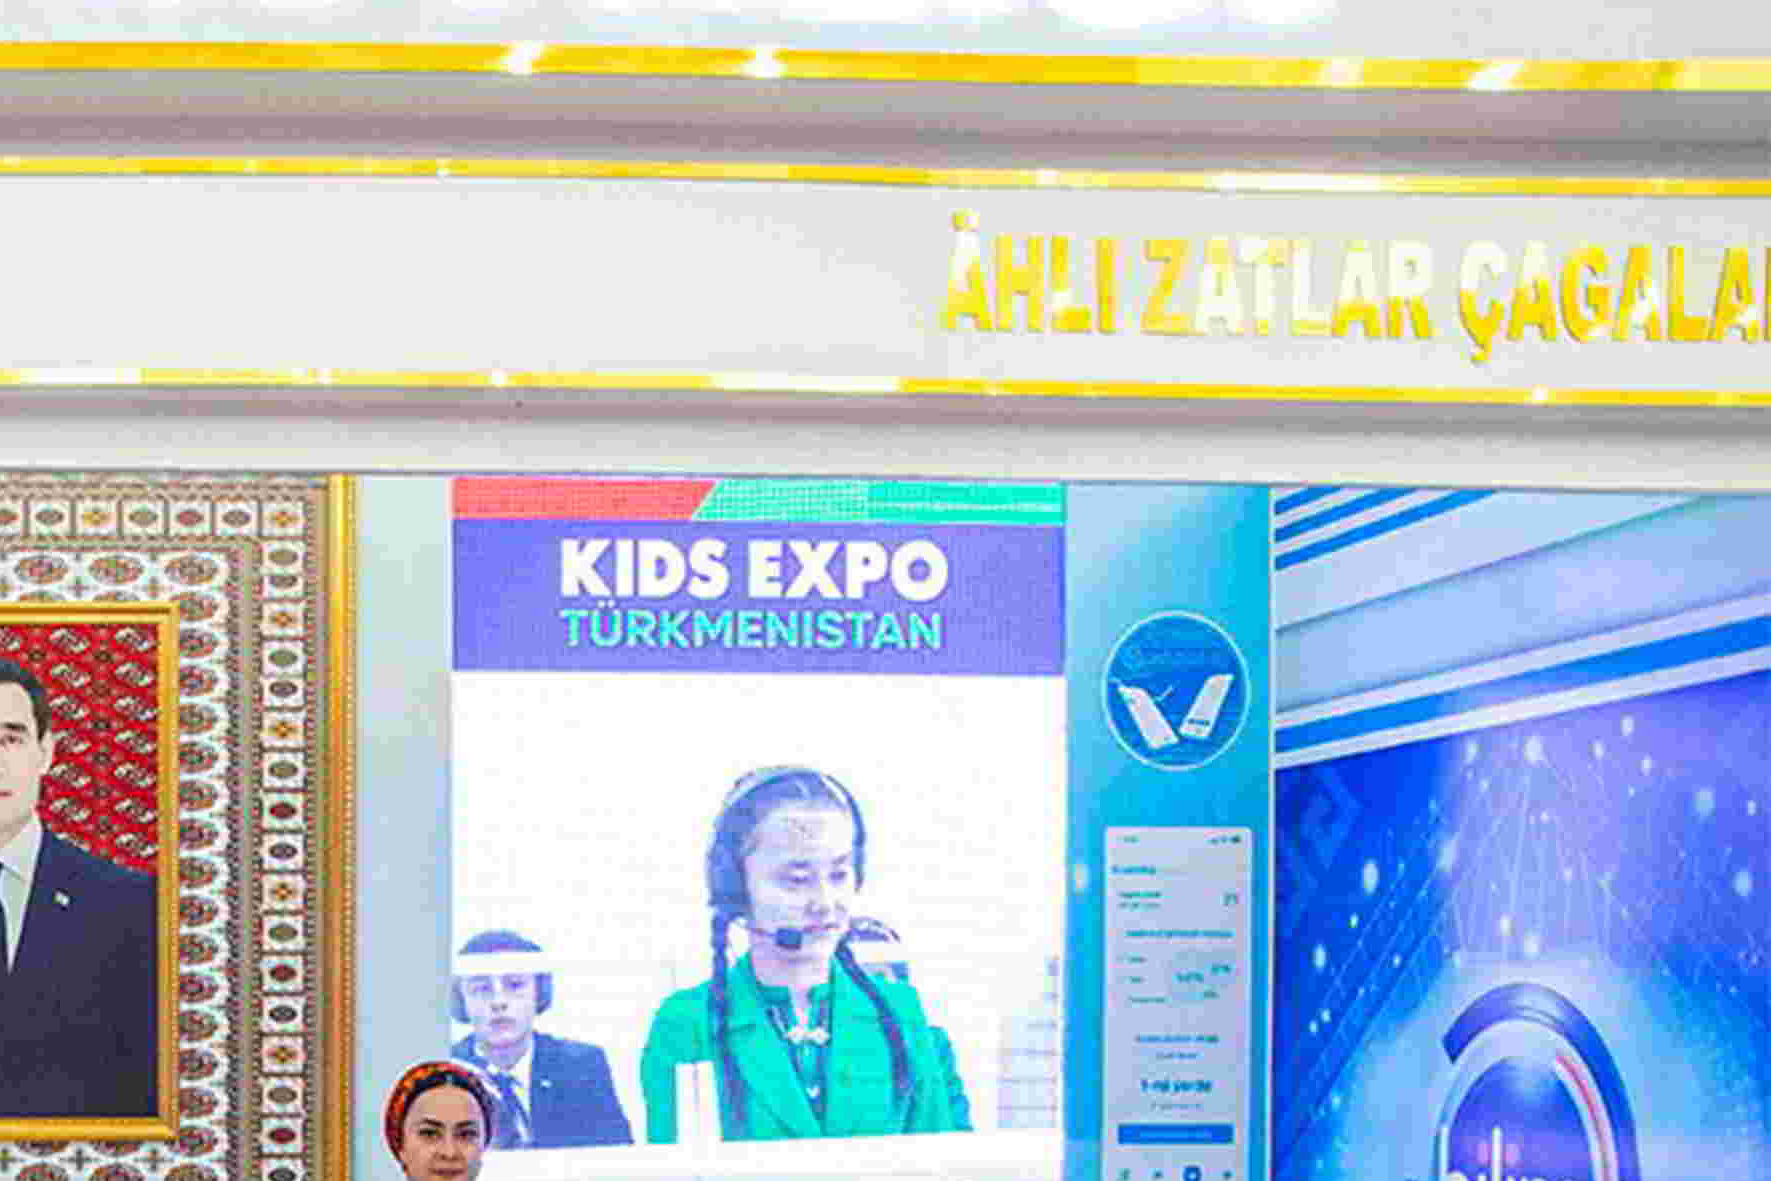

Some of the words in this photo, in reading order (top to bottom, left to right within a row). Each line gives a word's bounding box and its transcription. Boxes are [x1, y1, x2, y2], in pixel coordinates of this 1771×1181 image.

[1142, 236, 1434, 340] ZATLAR
[1458, 240, 1771, 364] ÇAGALA
[560, 539, 728, 600] KIDS
[748, 539, 949, 602] EXPO
[559, 600, 945, 651] TÜRKMENISTAN
